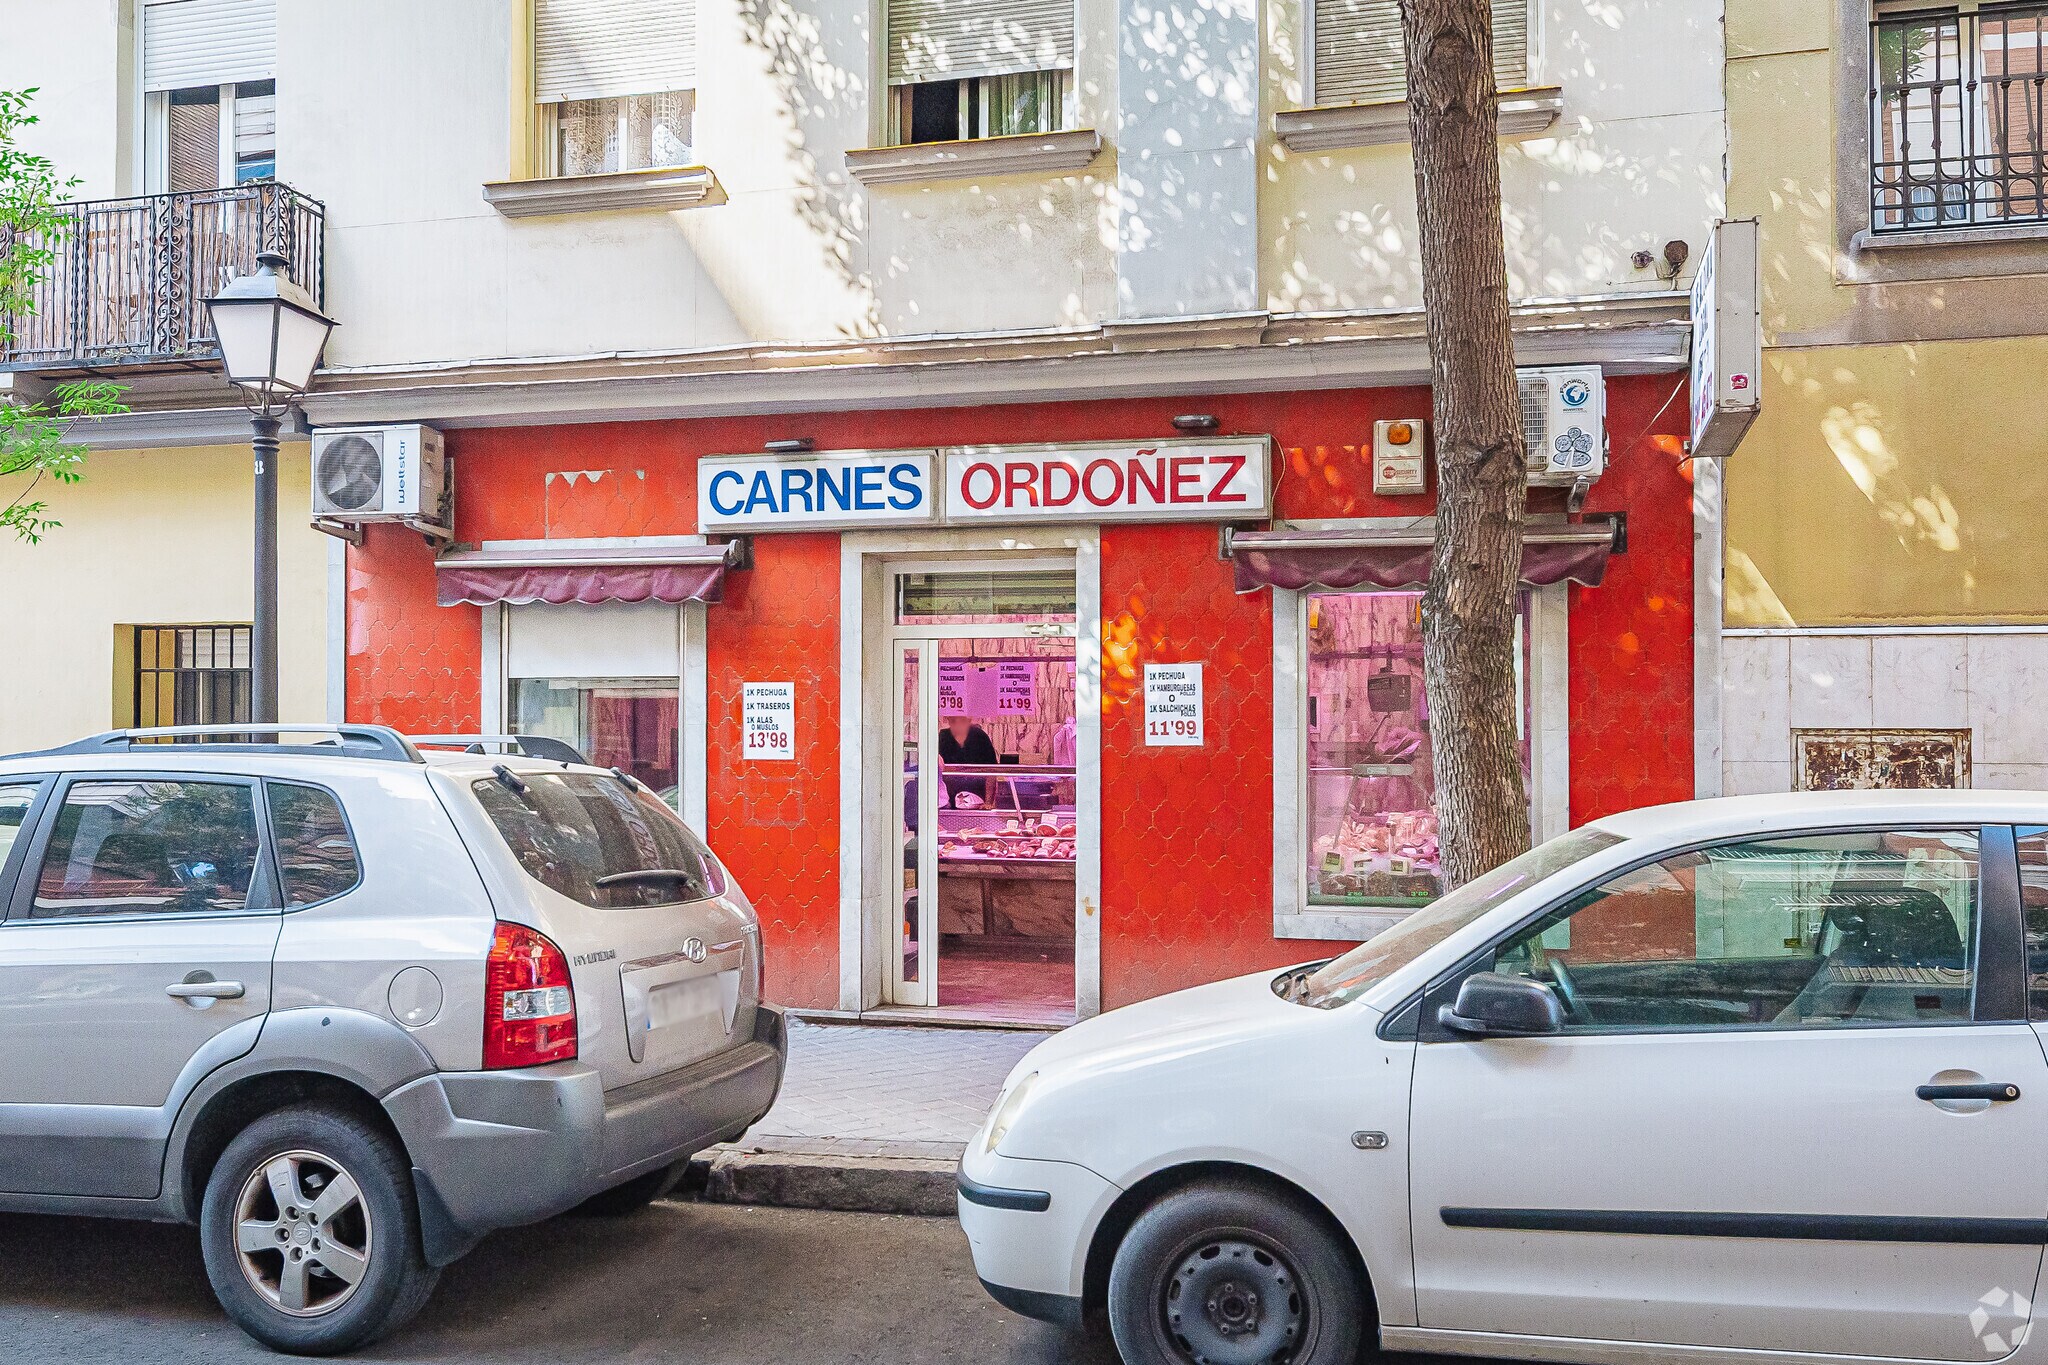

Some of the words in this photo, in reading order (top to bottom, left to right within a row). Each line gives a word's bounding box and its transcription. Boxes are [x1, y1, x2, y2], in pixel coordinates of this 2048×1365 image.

[709, 463, 923, 516] CARNES
[960, 448, 1247, 510] ORDOÑEZ
[1150, 672, 1157, 680] 1K
[1158, 672, 1185, 680] PECHUGA
[757, 688, 787, 696] PECHUGA
[1149, 684, 1156, 692] 1K
[1157, 683, 1196, 692] HAMBURGUESAS
[939, 696, 963, 708] 3'98
[1169, 694, 1176, 702] O
[757, 702, 790, 710] TRASEROS
[999, 698, 1031, 708] 11'99
[1149, 705, 1157, 713] 1K
[1159, 704, 1196, 713] SALCHICHAS
[1149, 720, 1196, 736] 11'99
[749, 732, 787, 748] 13'98
